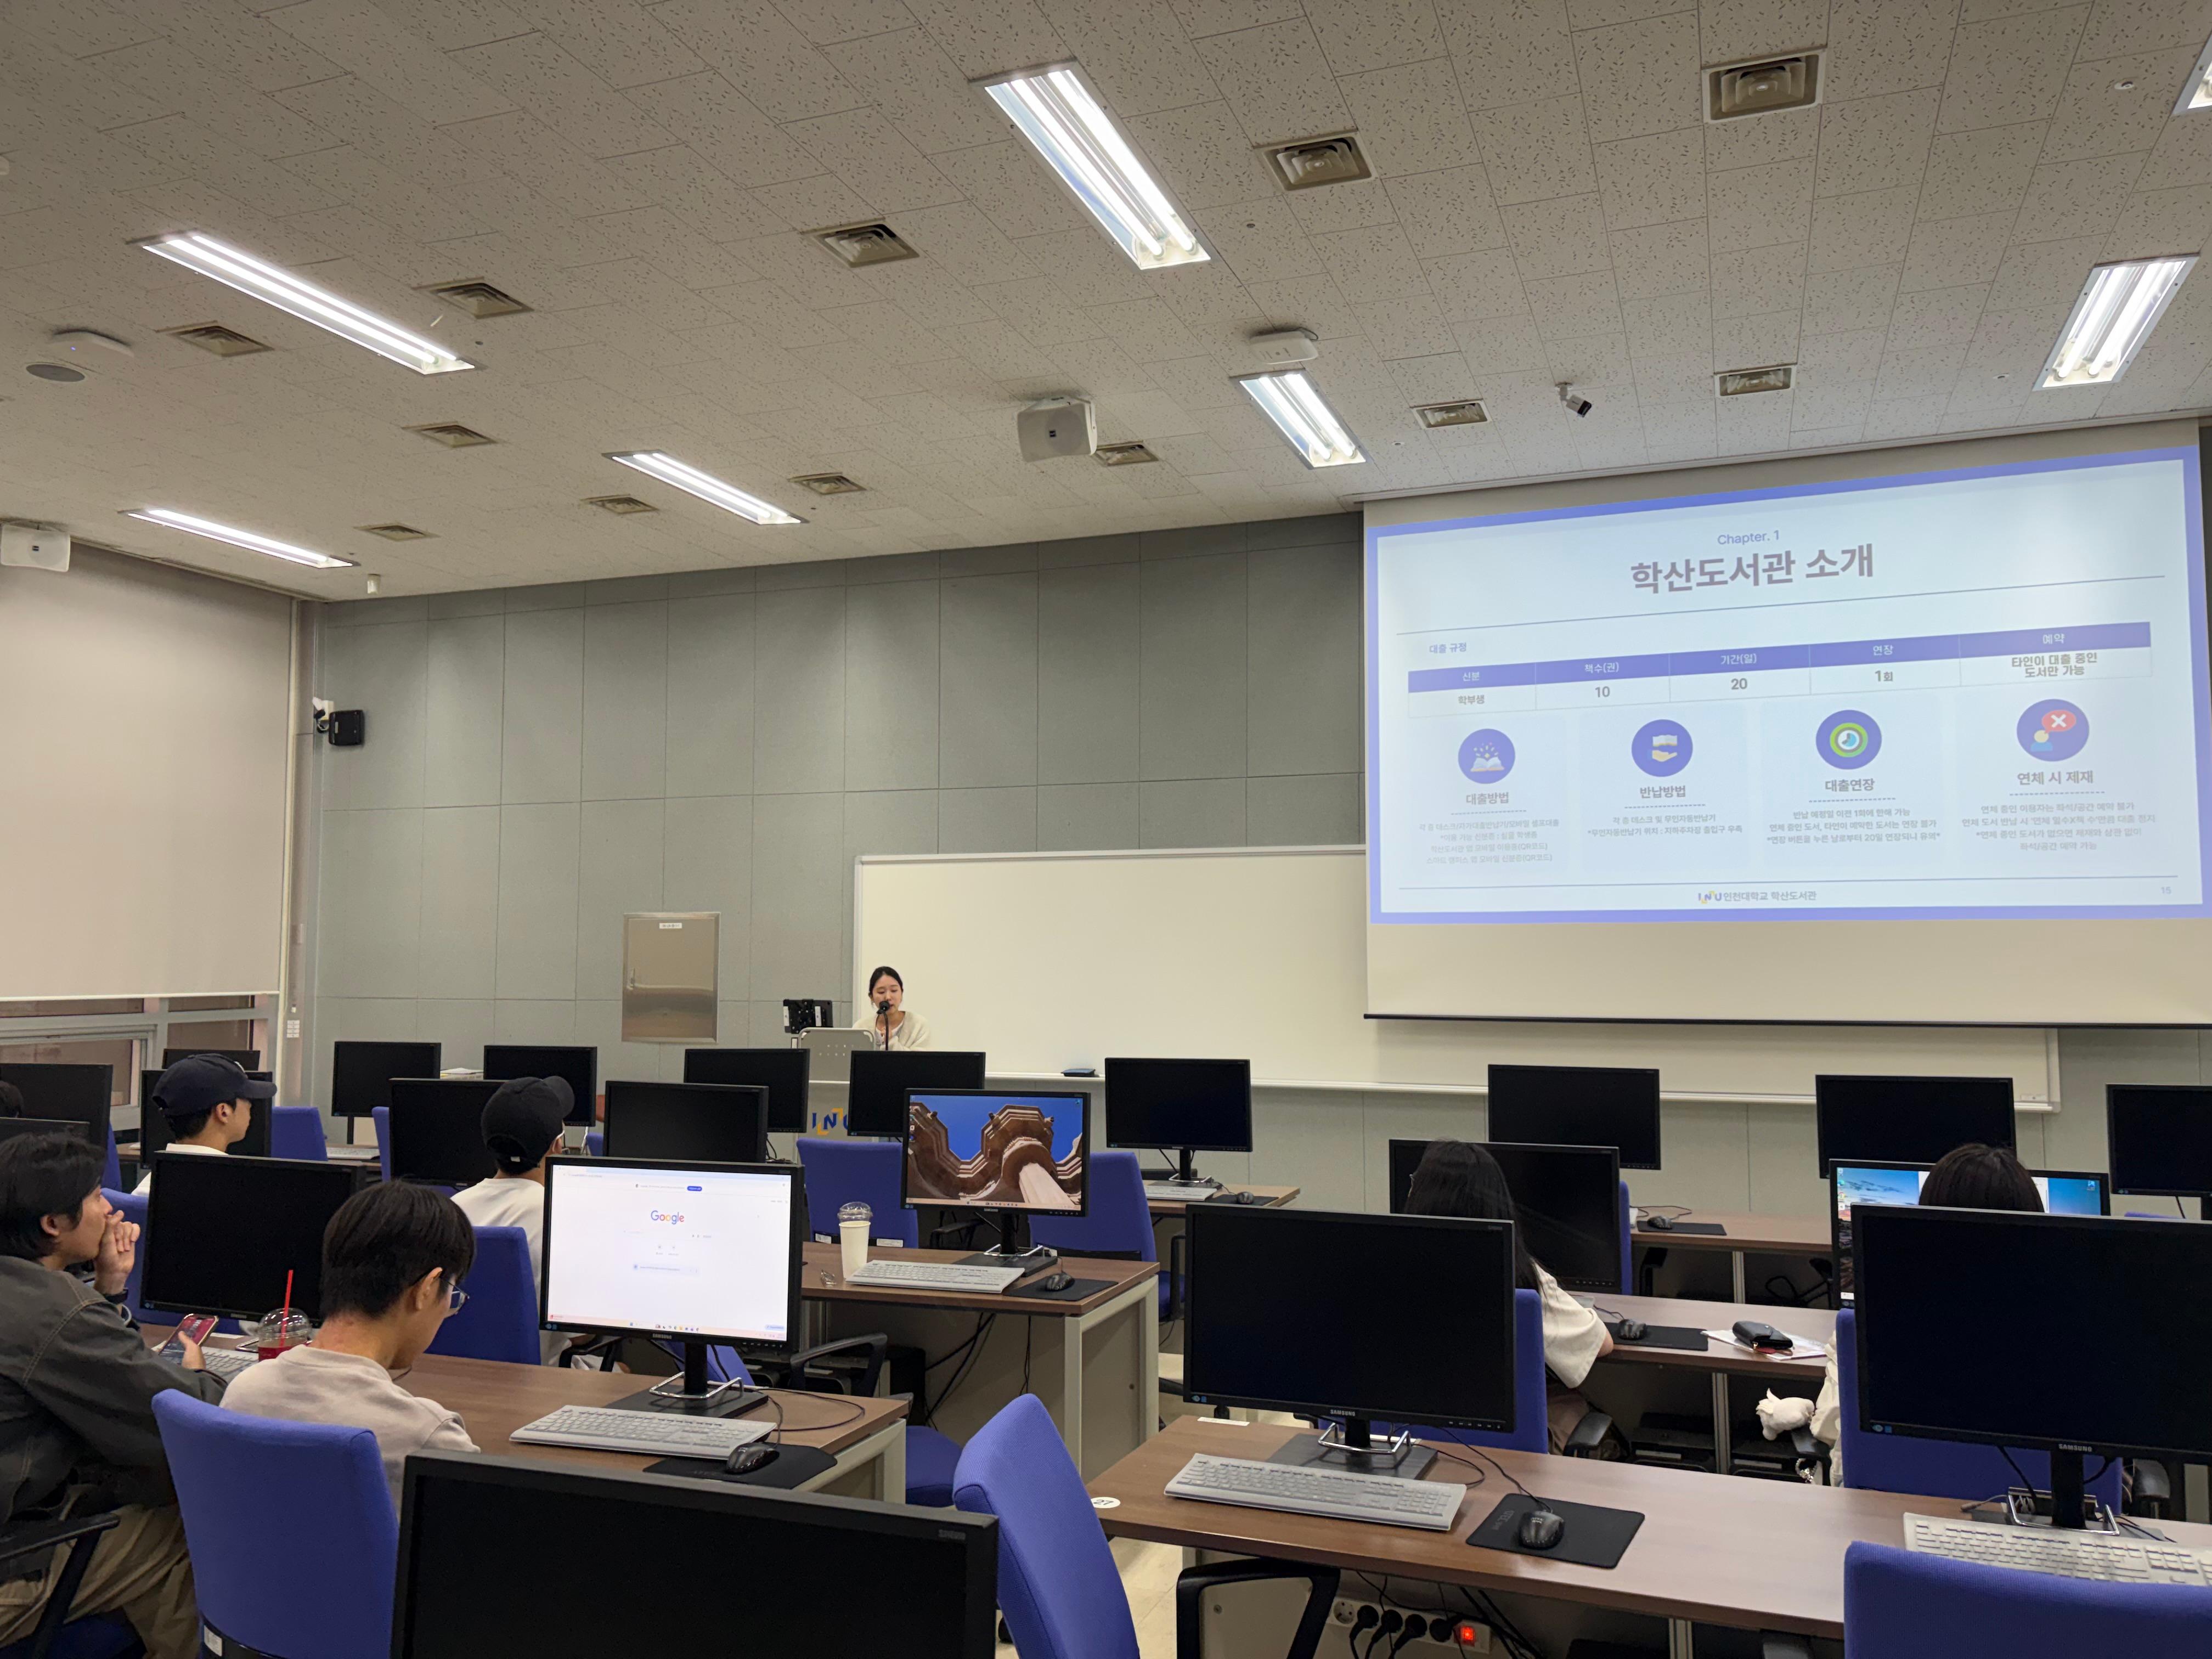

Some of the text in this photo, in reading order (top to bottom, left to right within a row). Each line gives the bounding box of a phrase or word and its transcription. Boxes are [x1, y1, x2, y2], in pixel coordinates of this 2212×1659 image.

[1717, 530, 1780, 546] Chapter. 1
[1631, 543, 1874, 595] 학산도서관 소개
[2042, 633, 2065, 645] 예약
[1429, 642, 1467, 654] 대출 규정
[1872, 644, 1893, 657] 연장
[1720, 653, 1757, 666] 기간(일)
[2011, 652, 2097, 668] 타인이 대출 중인
[1584, 661, 1619, 674] 책수(권)
[2025, 664, 2085, 678] 도서만 가능
[1462, 671, 1480, 682] 신분
[1875, 670, 1893, 682] 1회
[1731, 678, 1748, 691] 20
[1595, 686, 1610, 698] 10
[1457, 694, 1485, 705] 학부생
[2017, 770, 2094, 786] 연체 시 제재
[1825, 778, 1875, 792] 대출연장
[1466, 792, 1509, 805] 대출방법
[1640, 785, 1686, 799] 반납방법
[2160, 886, 2171, 894] 15
[1698, 891, 1816, 903] INU 인천대학교 학산도서관
[650, 1210, 685, 1225] Google
[2058, 1443, 2092, 1452] SAMSUNG
